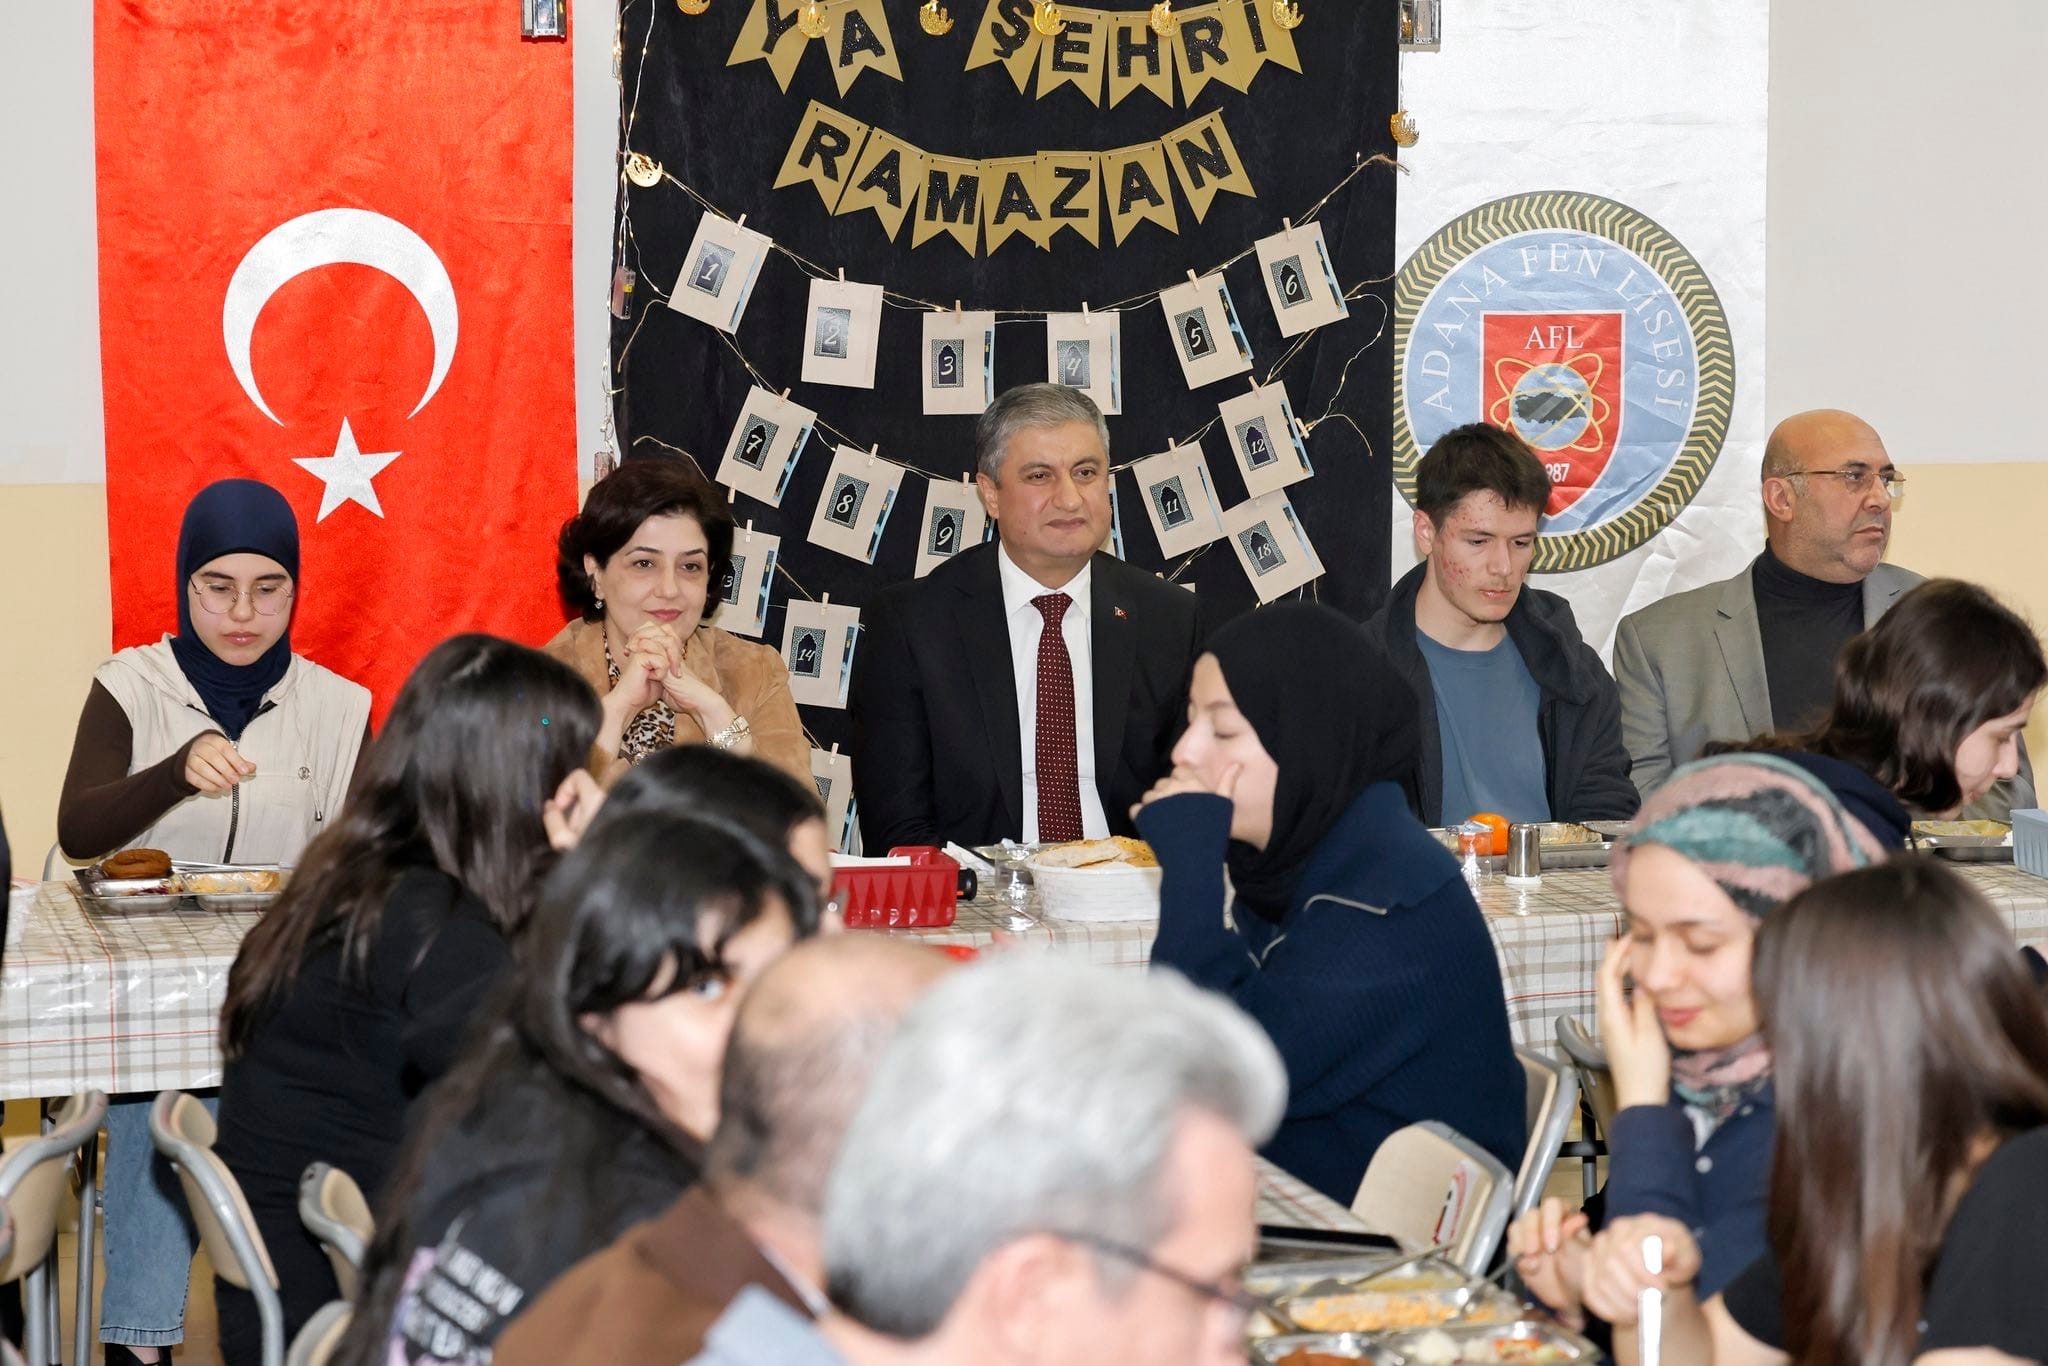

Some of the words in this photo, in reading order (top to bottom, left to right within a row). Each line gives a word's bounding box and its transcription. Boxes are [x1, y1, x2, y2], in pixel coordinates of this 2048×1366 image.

[761, 0, 886, 67] YA
[798, 120, 1233, 225] RAMAZAN
[700, 262, 719, 281] 1
[1284, 278, 1298, 295] 6
[823, 322, 842, 345] 2
[1421, 264, 1511, 412] ADANA
[1518, 241, 1607, 279] FEN
[1615, 268, 1688, 408] LİSESİ
[1190, 327, 1202, 348] 5
[1524, 325, 1584, 350] AFL
[939, 355, 954, 377] 3
[1066, 358, 1082, 377] 4
[747, 434, 764, 454] 7
[1250, 439, 1266, 456] 12
[1545, 462, 1571, 483] 987
[836, 494, 854, 514] 8
[1165, 499, 1179, 515] 11
[938, 526, 954, 546] 9
[1256, 543, 1272, 560] 18
[797, 648, 816, 662] 14
